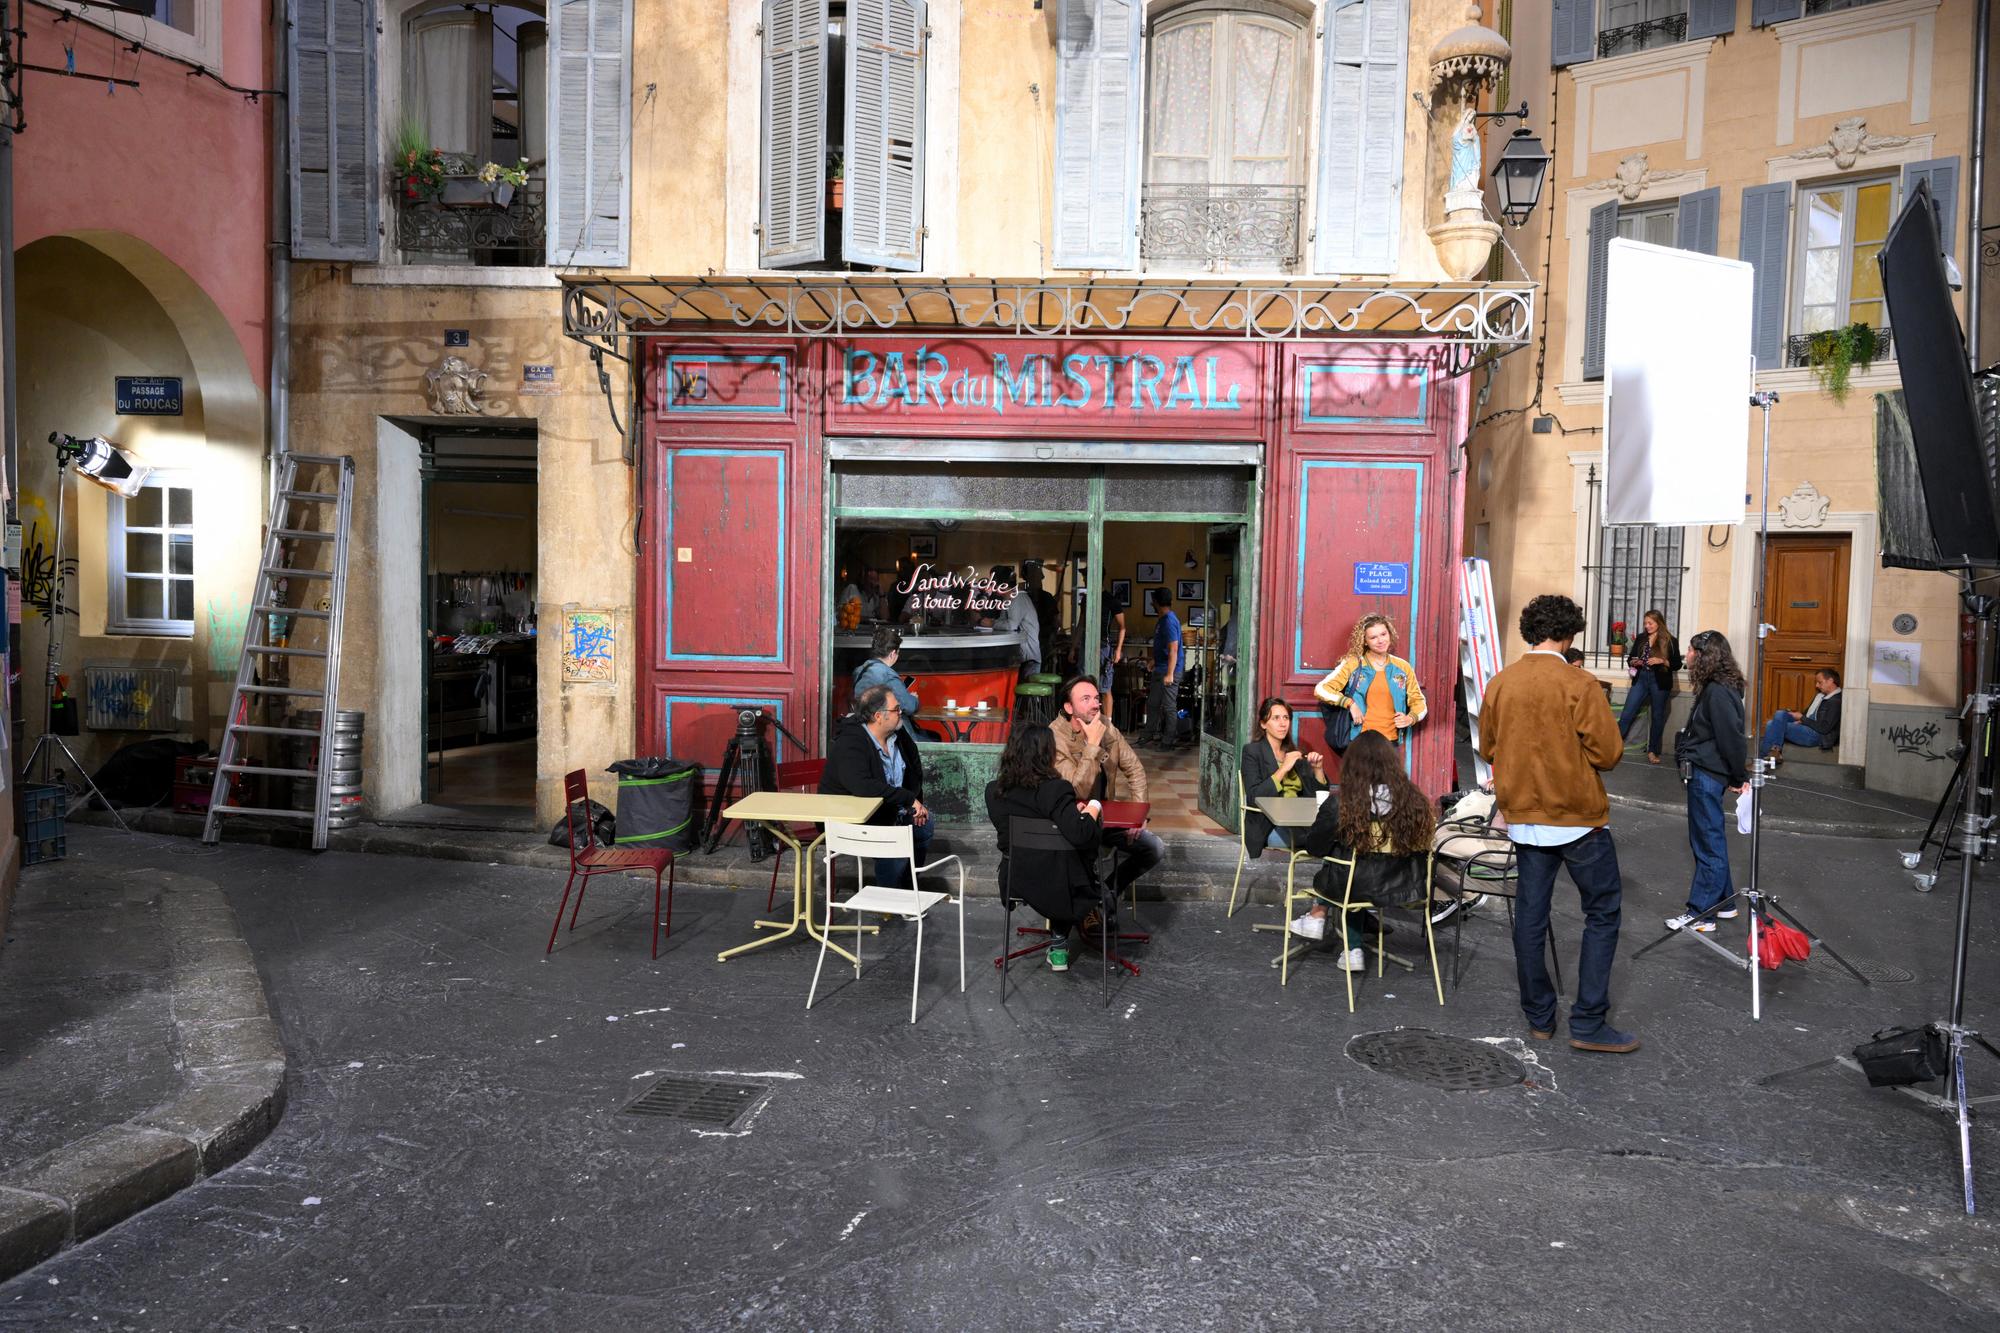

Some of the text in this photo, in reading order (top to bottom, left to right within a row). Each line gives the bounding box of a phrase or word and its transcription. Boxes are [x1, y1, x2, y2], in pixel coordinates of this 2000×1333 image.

[453, 332, 460, 344] 3
[842, 344, 1242, 416] BAR du MISTRAL
[131, 386, 165, 395] PASSAGE
[118, 398, 178, 410] DU ROUCAS
[896, 563, 1019, 598] Sandwiches
[911, 589, 1012, 610] à toute heure
